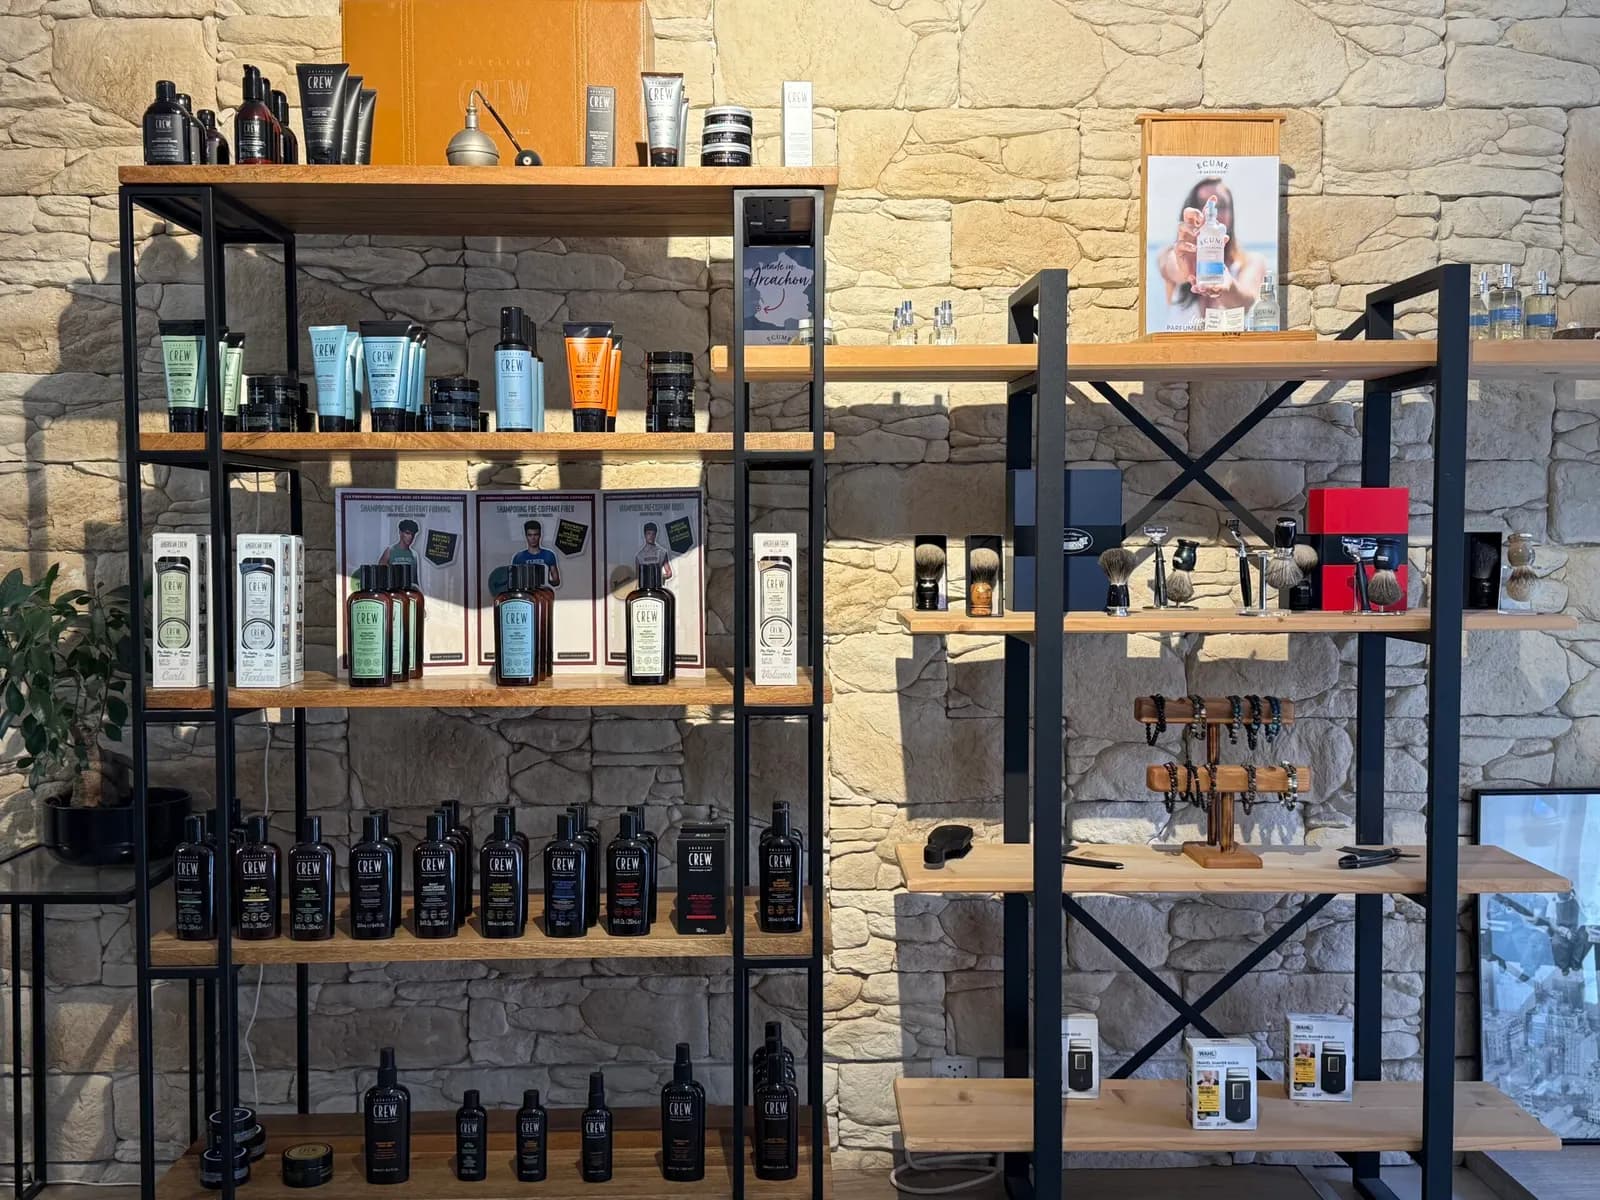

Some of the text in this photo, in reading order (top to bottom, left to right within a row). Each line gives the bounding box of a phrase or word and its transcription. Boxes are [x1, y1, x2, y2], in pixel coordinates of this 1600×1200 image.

[308, 76, 333, 88] CREW
[648, 88, 673, 101] CREW
[590, 96, 610, 108] CREW
[1196, 160, 1230, 170] ECUME
[762, 262, 784, 271] made
[748, 267, 810, 288] Arcachon
[169, 350, 191, 361] CREW
[314, 343, 336, 357] CREW
[372, 351, 394, 361] CREW
[578, 352, 599, 363] CREW
[501, 359, 524, 372] CREW
[164, 581, 182, 590] CREW
[249, 582, 267, 591] CREW
[766, 579, 784, 589] CREW
[357, 612, 378, 624] CREW
[505, 612, 527, 624] CREW
[636, 611, 657, 622] CREW
[421, 858, 445, 871] CREW
[490, 858, 513, 871] CREW
[552, 858, 575, 871] CREW
[616, 857, 639, 870] CREW
[688, 853, 712, 865] CREW
[769, 855, 792, 867] CREW
[177, 862, 198, 875] CREW
[243, 861, 266, 874] CREW
[297, 862, 320, 875] CREW
[358, 860, 382, 872] CREW
[373, 1104, 398, 1118] CREW
[669, 1103, 692, 1115] CREW
[765, 1101, 788, 1114] CREW
[460, 1123, 477, 1133] CREW
[522, 1122, 539, 1133] CREW
[586, 1122, 606, 1134] CREW
